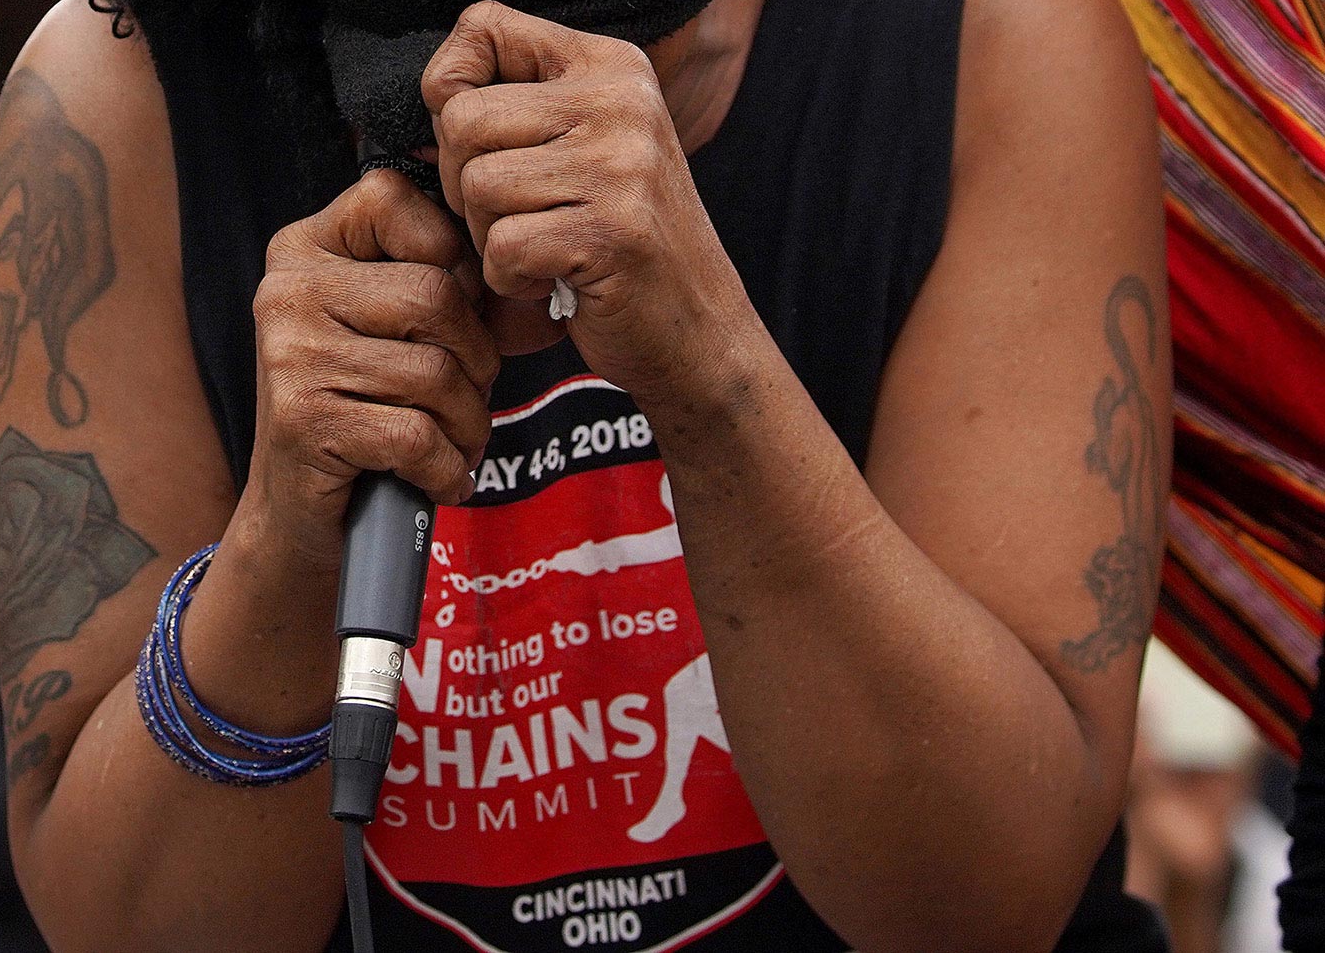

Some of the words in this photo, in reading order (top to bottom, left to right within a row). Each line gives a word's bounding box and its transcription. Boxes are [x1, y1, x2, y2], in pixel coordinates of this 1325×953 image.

[470, 456, 523, 492] AY
[571, 414, 652, 458] 2018
[551, 621, 588, 650] to
[599, 609, 677, 641] lose
[445, 685, 503, 718] but
[513, 672, 563, 708] our
[384, 694, 657, 789] CHAINS
[383, 772, 640, 832] SUMMIT
[512, 869, 686, 924] CINCINNATI
[563, 913, 641, 948] OHIO
